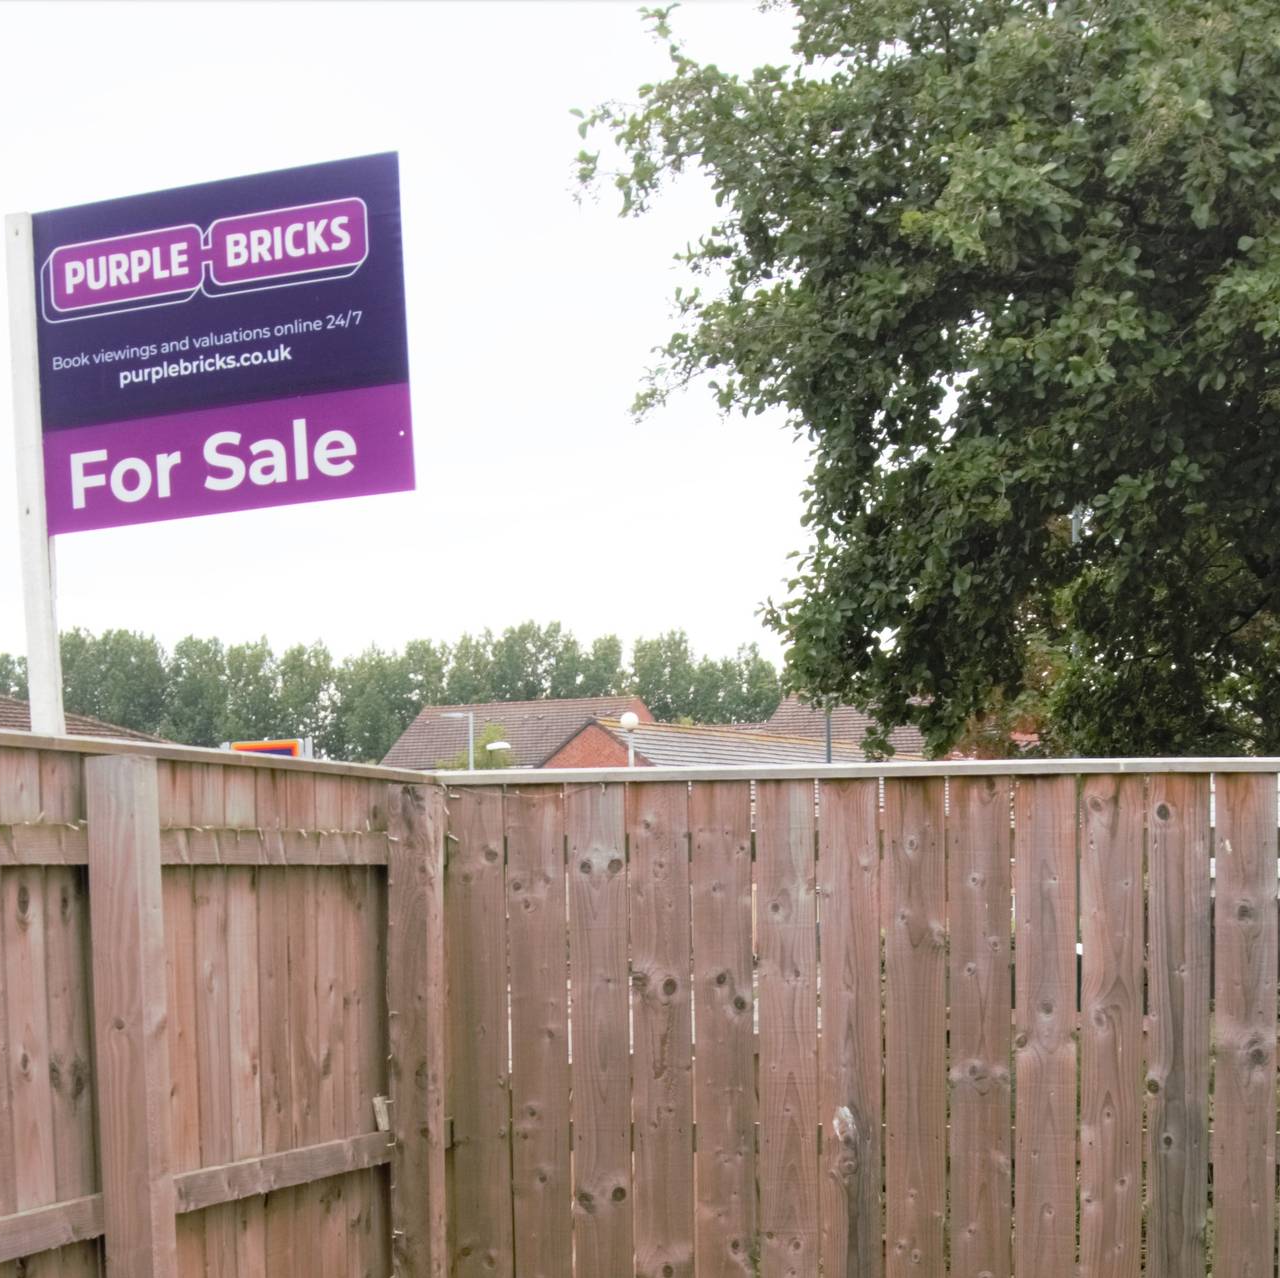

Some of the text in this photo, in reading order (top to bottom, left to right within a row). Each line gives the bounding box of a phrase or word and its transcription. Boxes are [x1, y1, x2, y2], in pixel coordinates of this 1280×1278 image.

[64, 215, 352, 295] PURPLE BRICKS
[52, 310, 363, 371] Book viewings and valuations online 24/7
[119, 343, 293, 389] purplebricks.co.uk
[69, 418, 358, 510] For Sale
